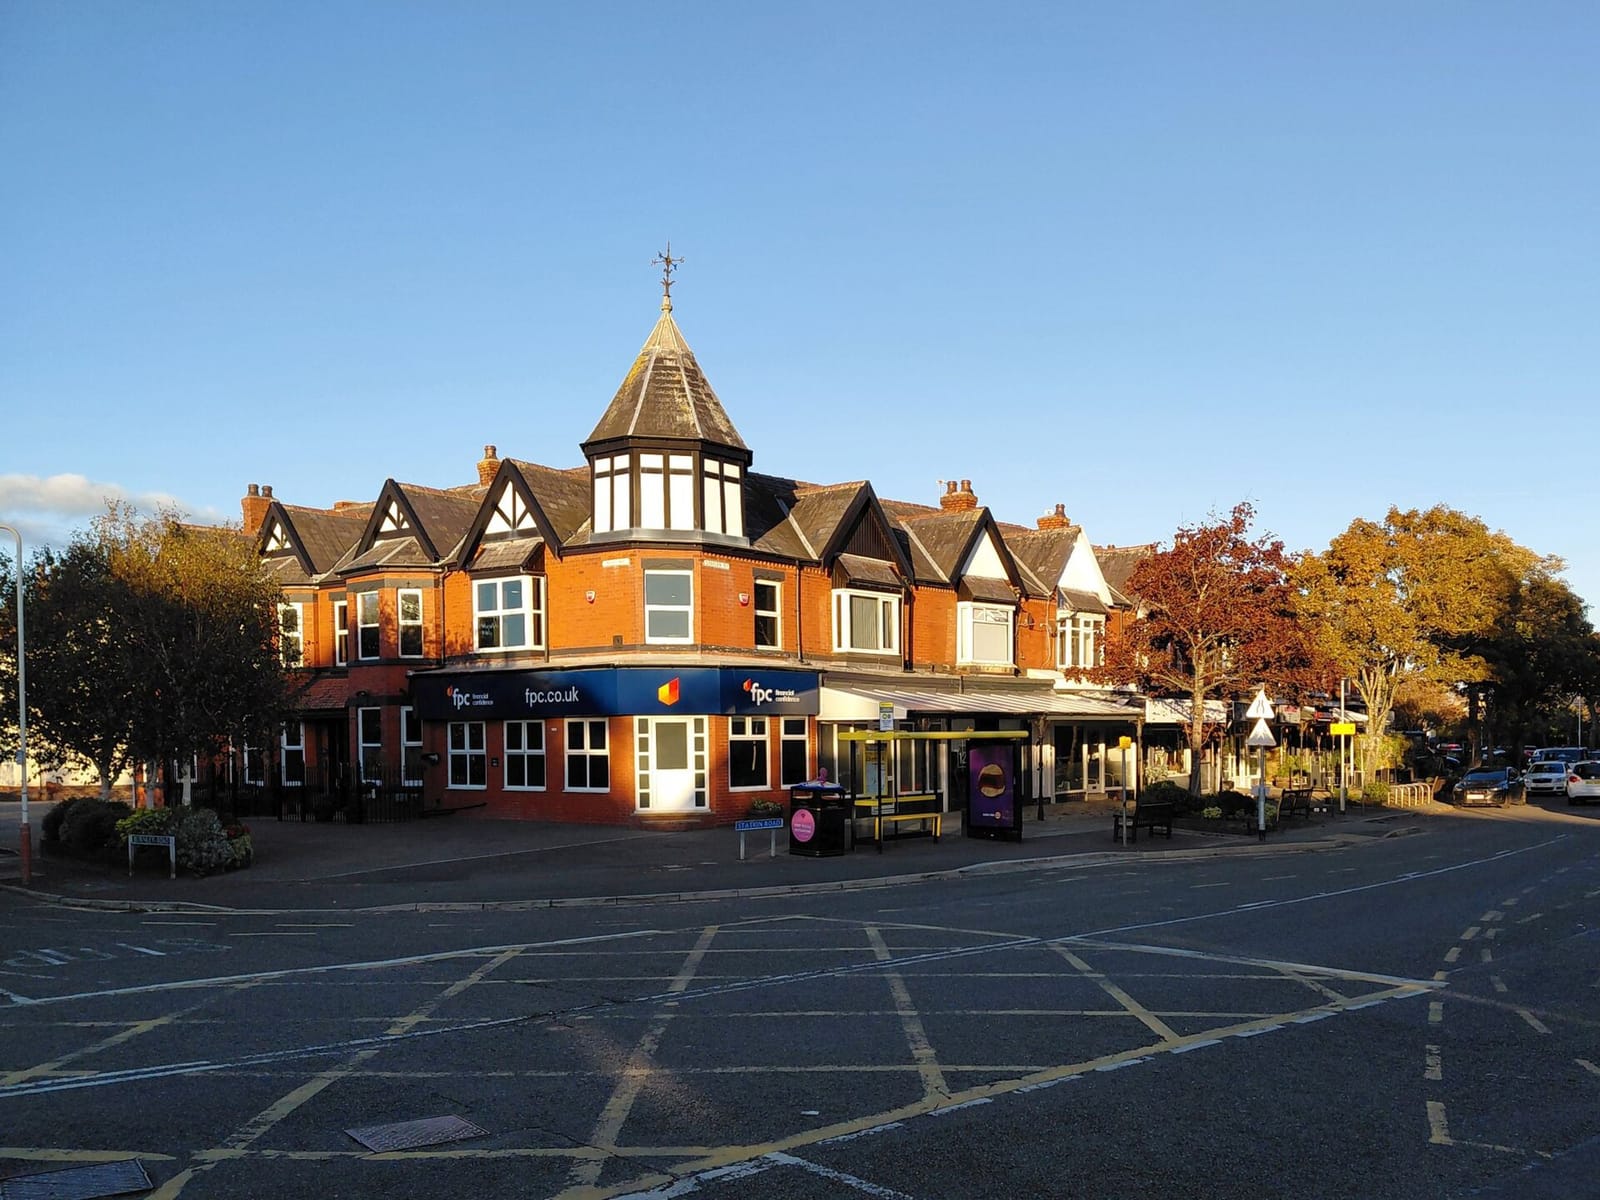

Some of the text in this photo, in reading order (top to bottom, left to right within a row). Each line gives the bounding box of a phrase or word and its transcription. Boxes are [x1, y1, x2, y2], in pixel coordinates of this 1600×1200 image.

[452, 687, 470, 710] fpc
[525, 686, 579, 707] fpc.co.uk
[750, 682, 773, 706] fpc
[764, 819, 781, 827] ROAD
